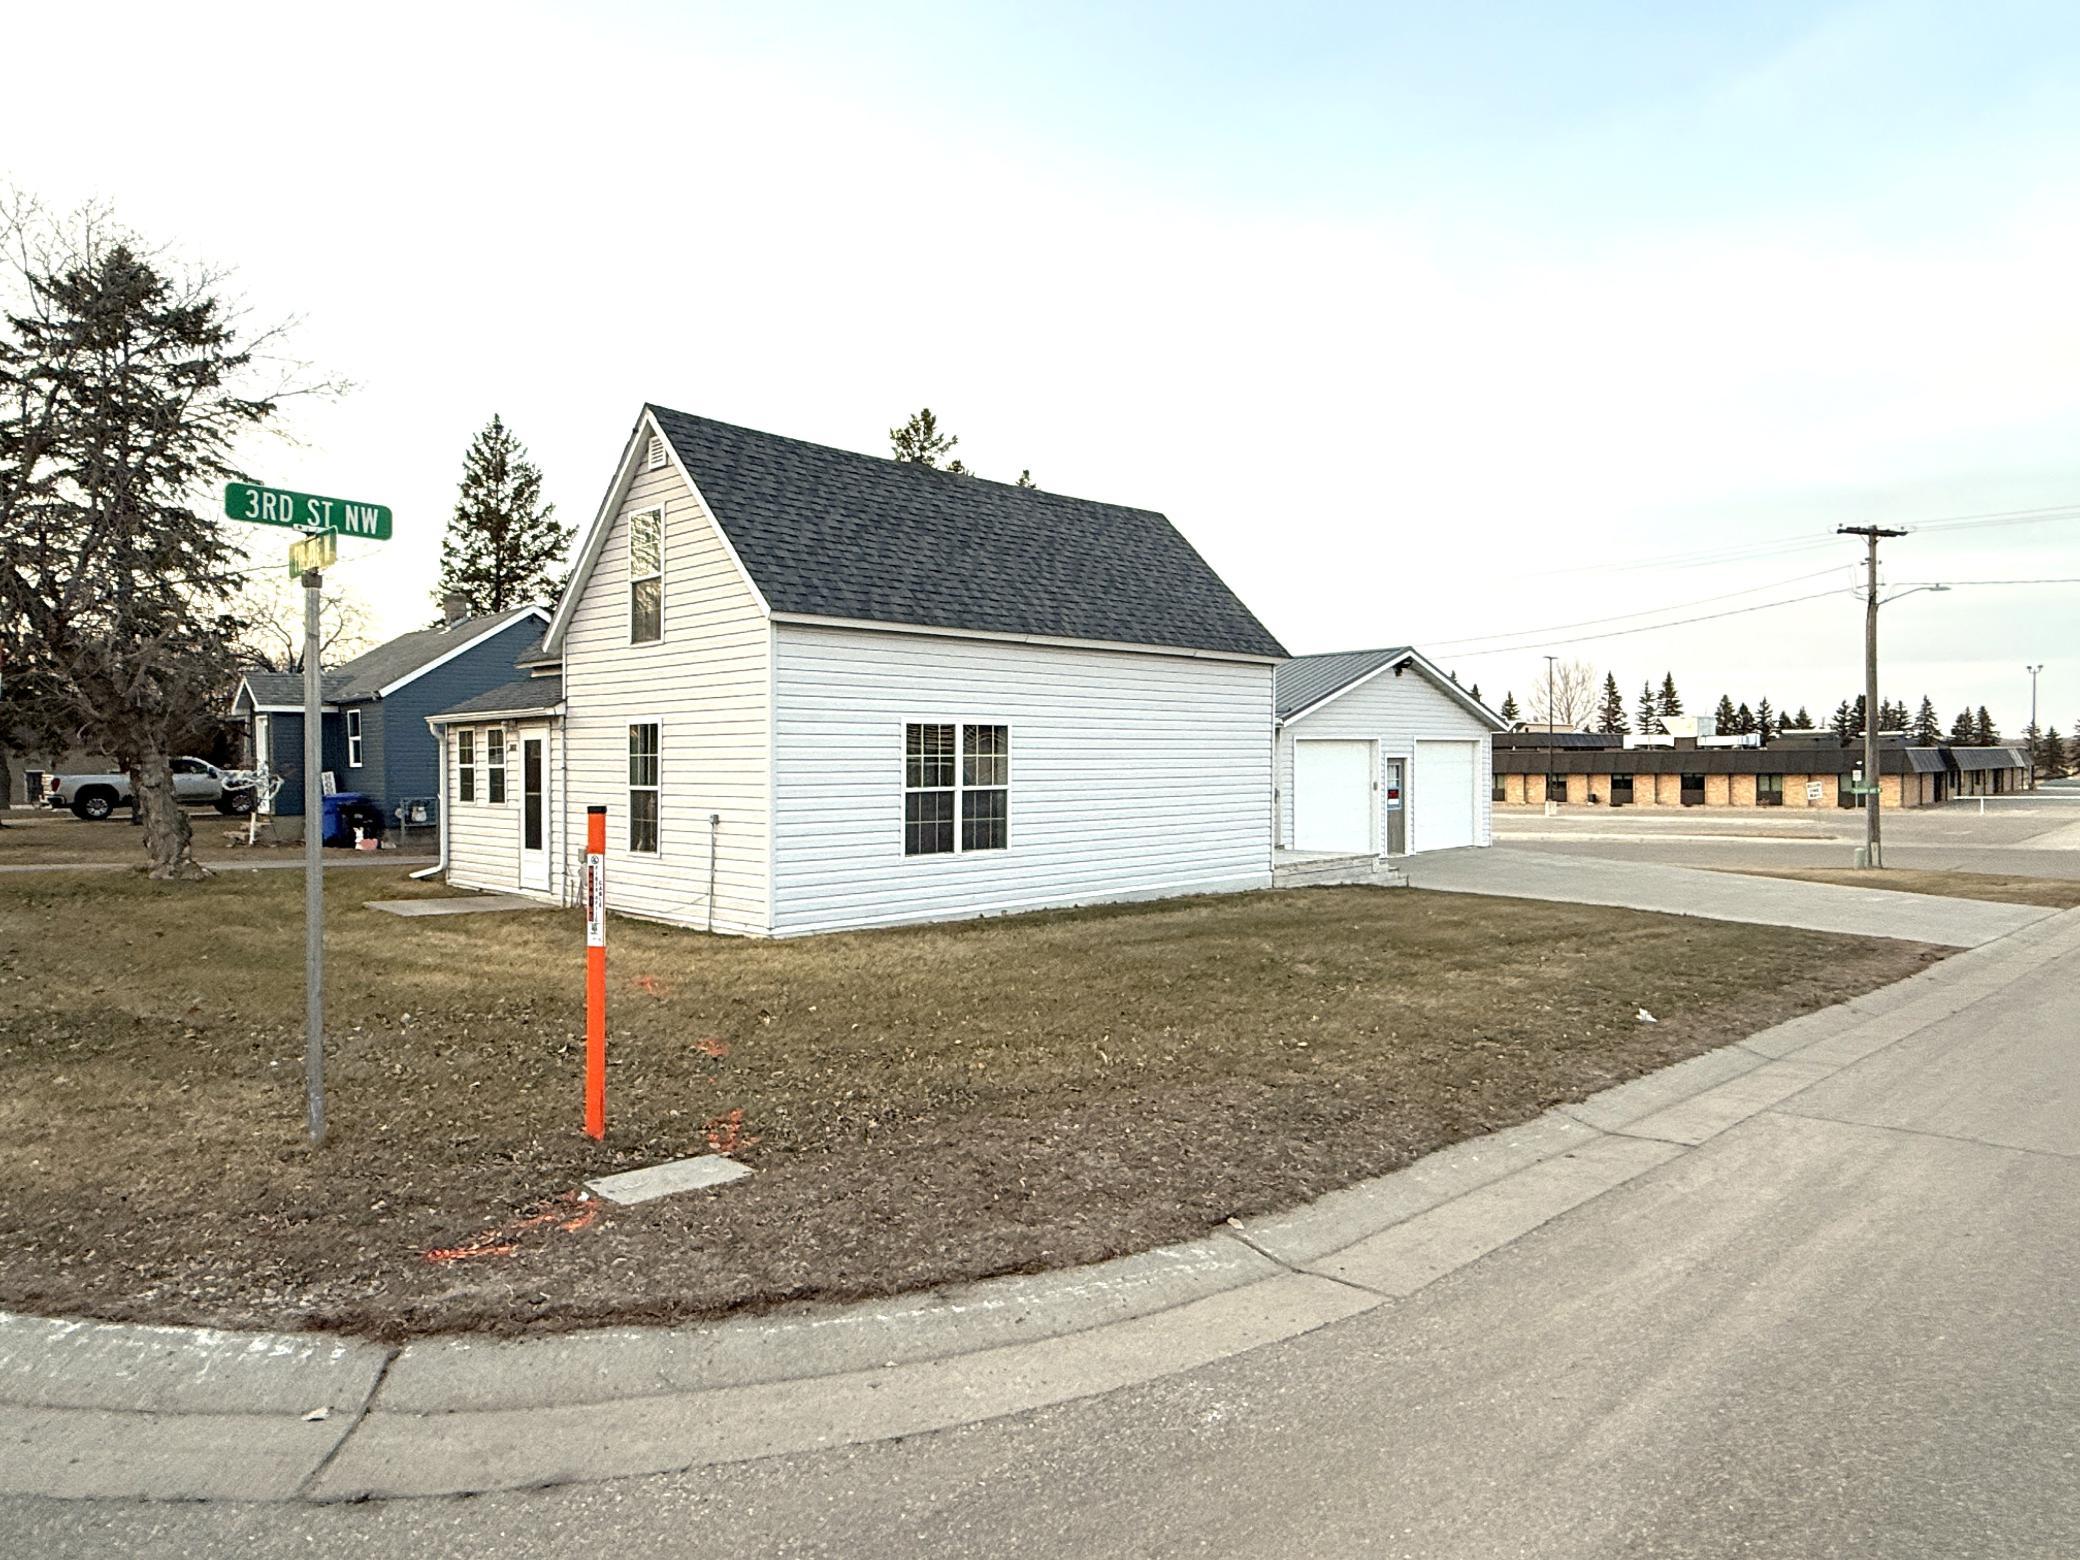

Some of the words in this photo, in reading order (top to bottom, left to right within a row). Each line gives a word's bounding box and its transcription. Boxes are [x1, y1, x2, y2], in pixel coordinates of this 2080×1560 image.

[245, 489, 294, 522] 3RD
[307, 498, 333, 528] ST
[345, 504, 379, 535] NW
